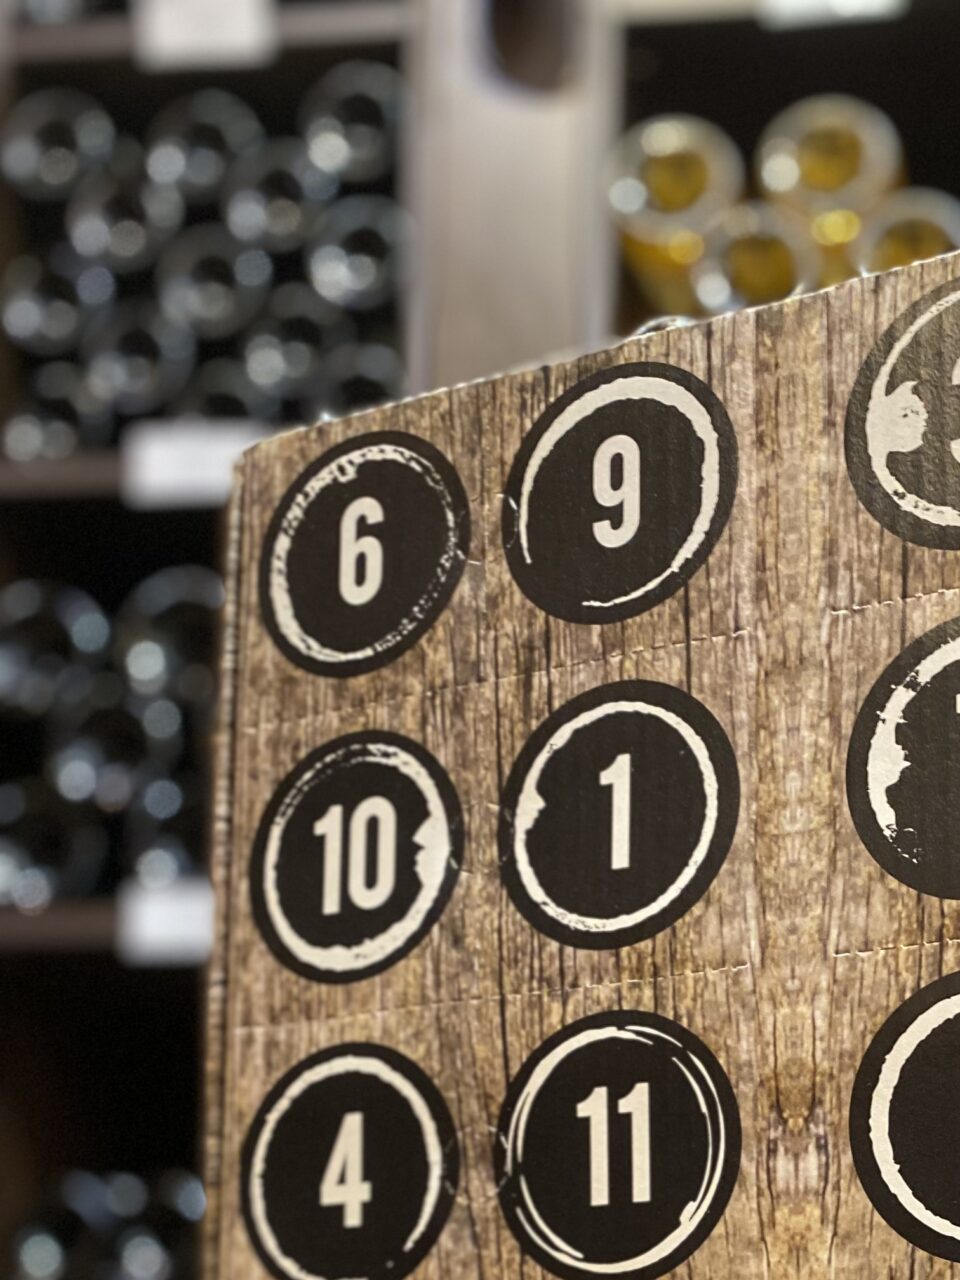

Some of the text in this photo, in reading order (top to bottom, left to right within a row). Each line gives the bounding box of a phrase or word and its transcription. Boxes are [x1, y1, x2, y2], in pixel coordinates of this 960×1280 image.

[593, 435, 640, 548] 9
[340, 497, 383, 605] 6
[313, 795, 397, 915] 10
[599, 753, 631, 870] 1
[319, 1111, 372, 1228] 4
[576, 1082, 651, 1207] 11
